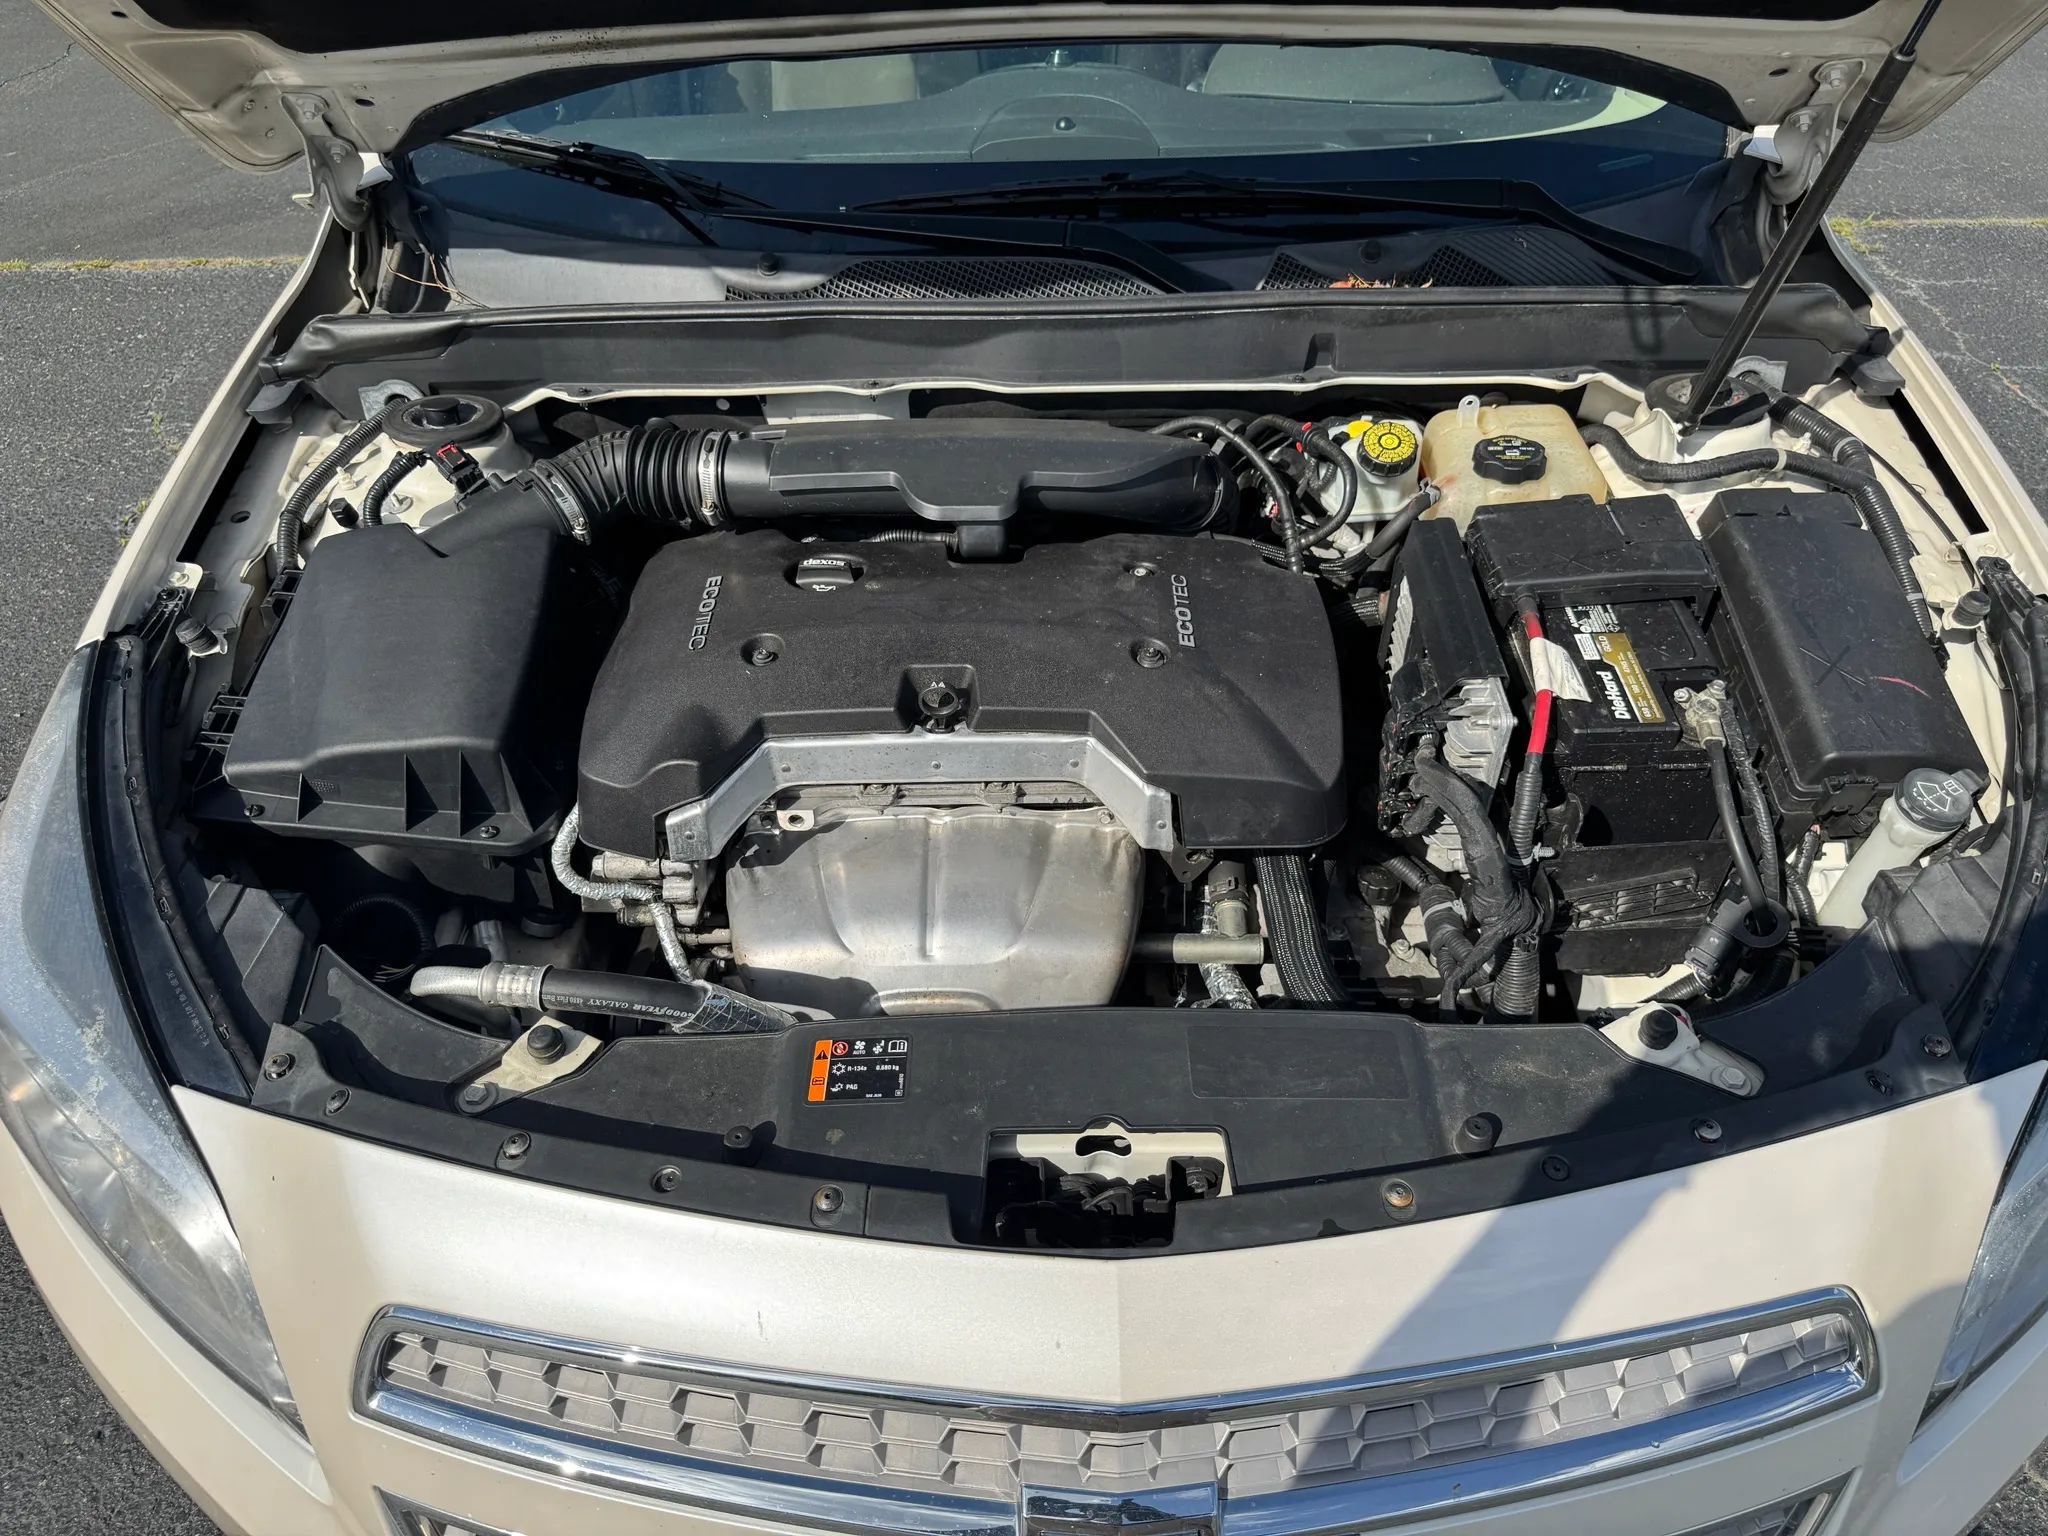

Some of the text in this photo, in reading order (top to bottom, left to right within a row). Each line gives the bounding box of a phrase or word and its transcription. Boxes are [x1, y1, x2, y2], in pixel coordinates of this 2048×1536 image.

[803, 558, 846, 566] dexos
[688, 575, 723, 650] ECOTEC
[1171, 574, 1195, 648] ECOTEC
[1598, 635, 1612, 652] GOLD
[1596, 671, 1631, 719] DieHard
[588, 998, 629, 1009] GALAXY
[632, 1003, 695, 1019] GOODYEAR
